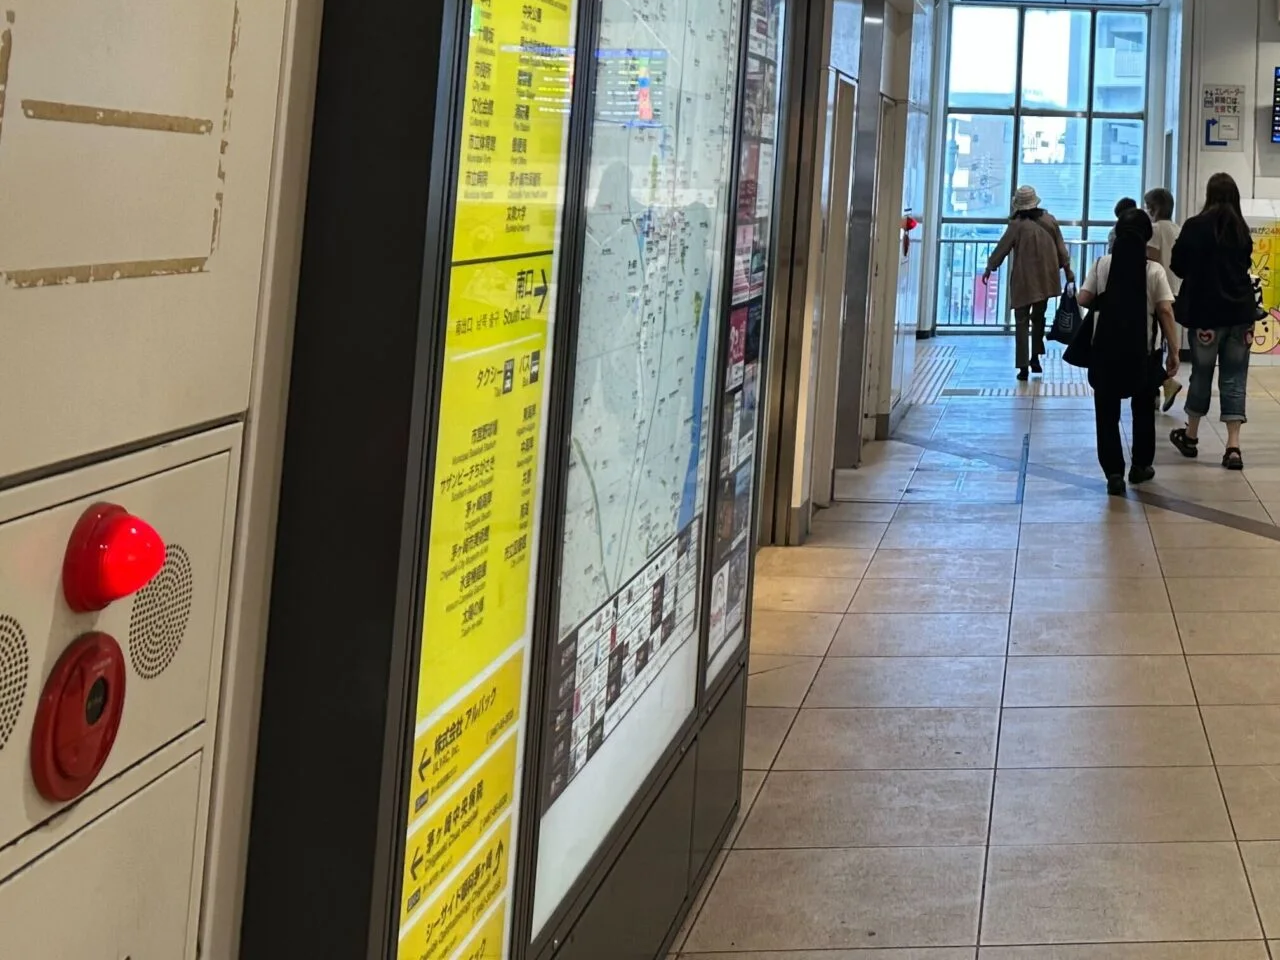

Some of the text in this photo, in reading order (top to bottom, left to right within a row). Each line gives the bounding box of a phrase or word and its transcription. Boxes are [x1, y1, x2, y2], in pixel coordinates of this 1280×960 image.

[515, 269, 533, 299] 南口
[502, 305, 520, 325] South
[476, 362, 503, 389] タクシー
[518, 354, 530, 373] バス
[433, 712, 463, 760] 株式会社
[464, 682, 496, 730] アルバック
